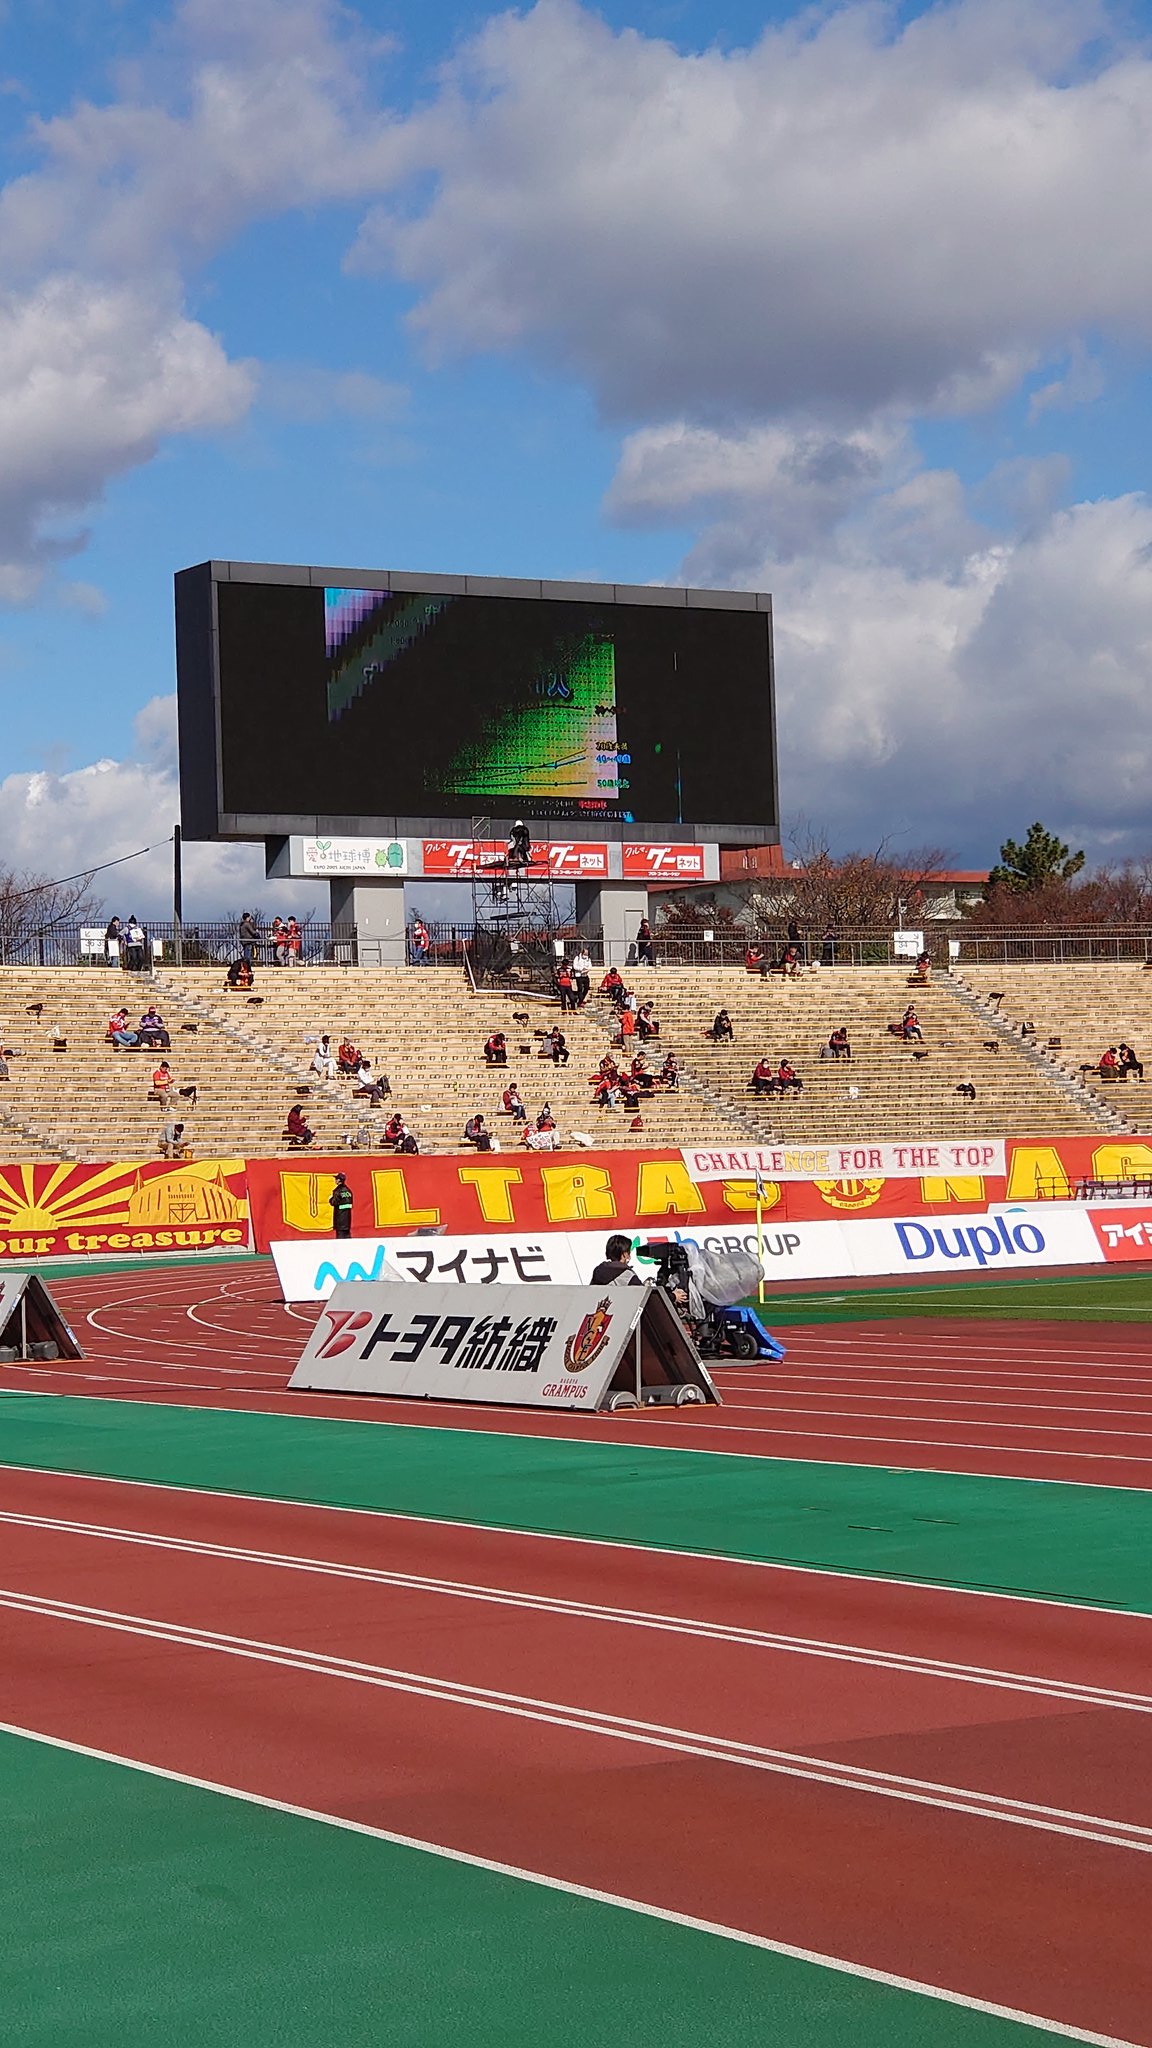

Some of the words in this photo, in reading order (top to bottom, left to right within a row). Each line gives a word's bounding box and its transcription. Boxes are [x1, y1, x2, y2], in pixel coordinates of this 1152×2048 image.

[549, 846, 579, 867] グー
[581, 856, 602, 866] ネット
[646, 848, 677, 869] グー
[678, 857, 699, 868] ネット
[693, 1150, 830, 1172] CHALLENGE
[840, 1149, 884, 1170] FOR
[894, 1147, 939, 1168] THE
[952, 1146, 995, 1168] TOP
[280, 1161, 782, 1232] ULTRAS
[0, 1235, 55, 1253] ur
[65, 1228, 243, 1250] treasure
[893, 1216, 1046, 1266] Duplo
[396, 1245, 552, 1284] マイナビ
[358, 1312, 558, 1373] トヨタ紡織
[542, 1383, 588, 1399] GRAMPUS
